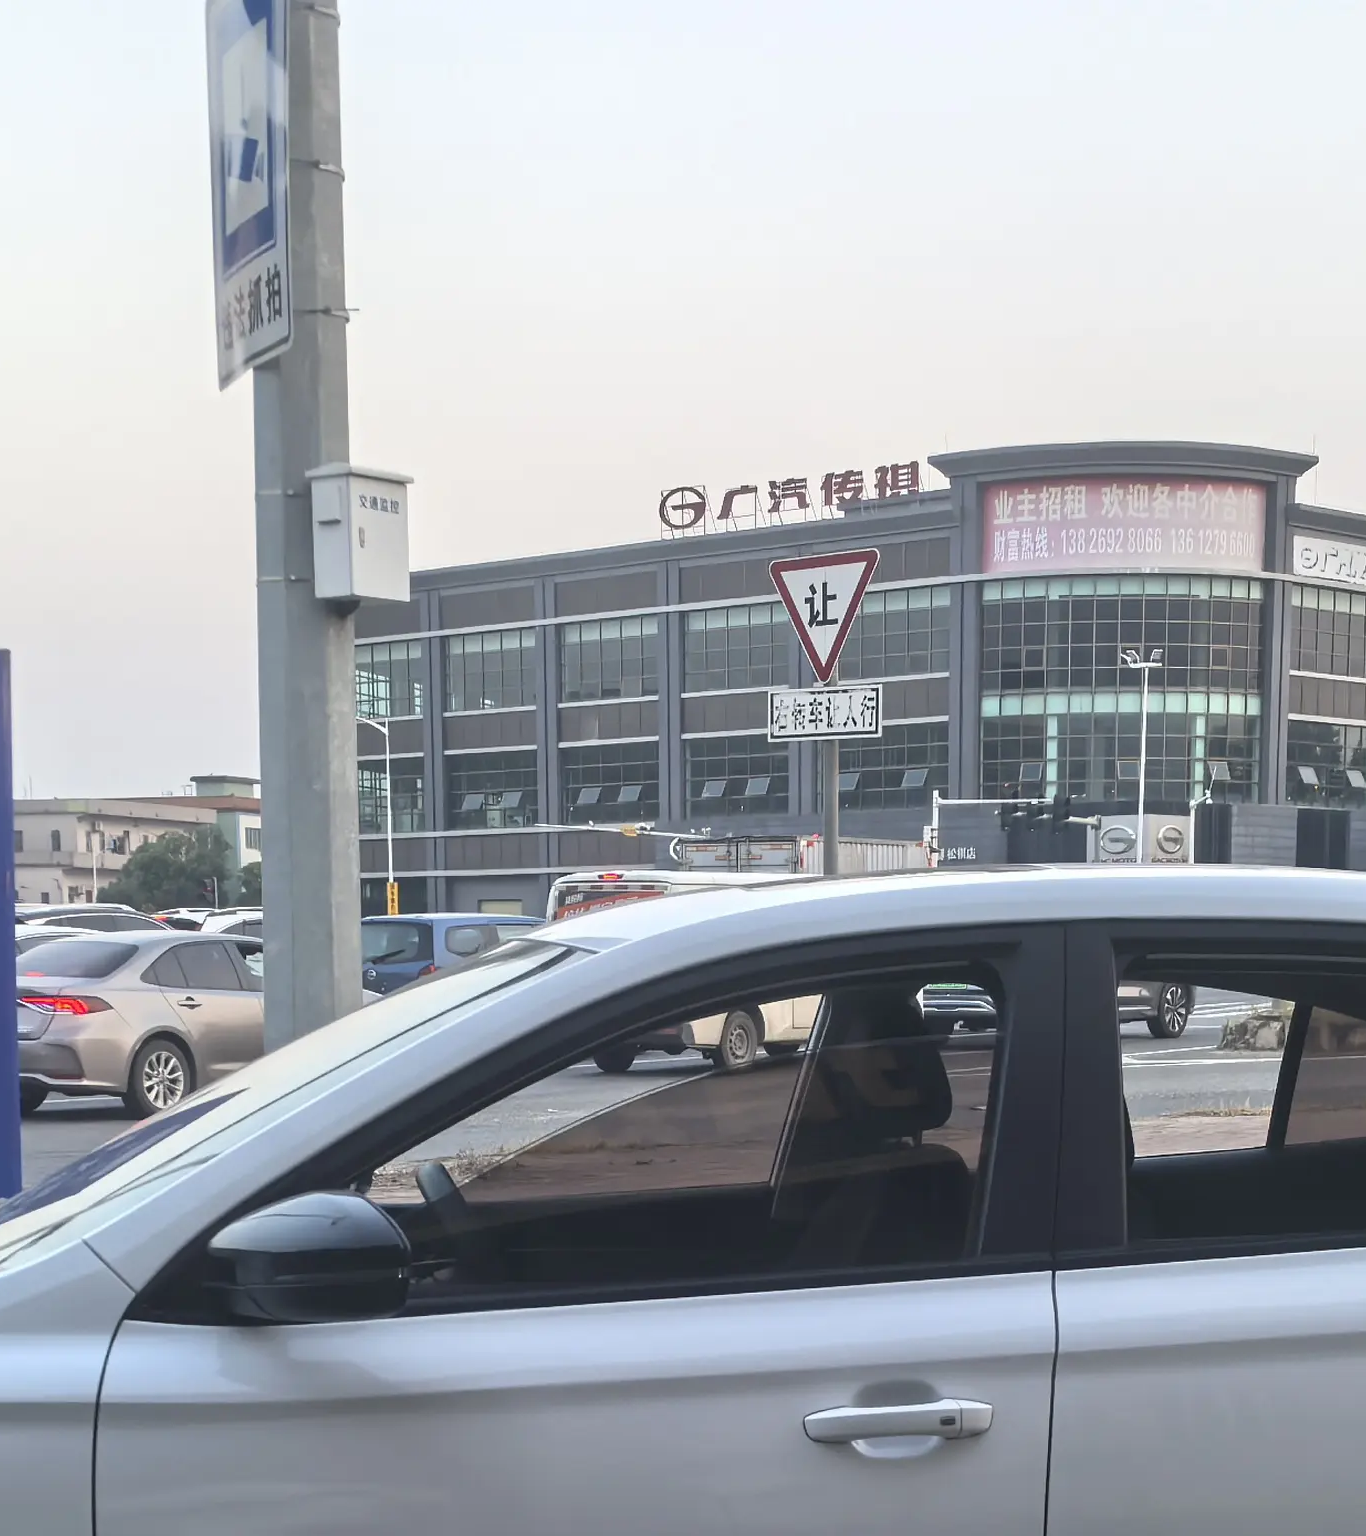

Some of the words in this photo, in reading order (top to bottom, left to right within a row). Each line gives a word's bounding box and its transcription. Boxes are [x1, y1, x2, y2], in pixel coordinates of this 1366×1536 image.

[994, 484, 1087, 524] 业主招租
[1101, 483, 1258, 526] 欢迎各中介合作
[1061, 529, 1086, 554] 138
[1089, 527, 1124, 555] 2692
[1127, 527, 1162, 554] 8066
[1171, 527, 1194, 554] 136
[1198, 528, 1226, 556] 1279
[805, 582, 838, 628] 让
